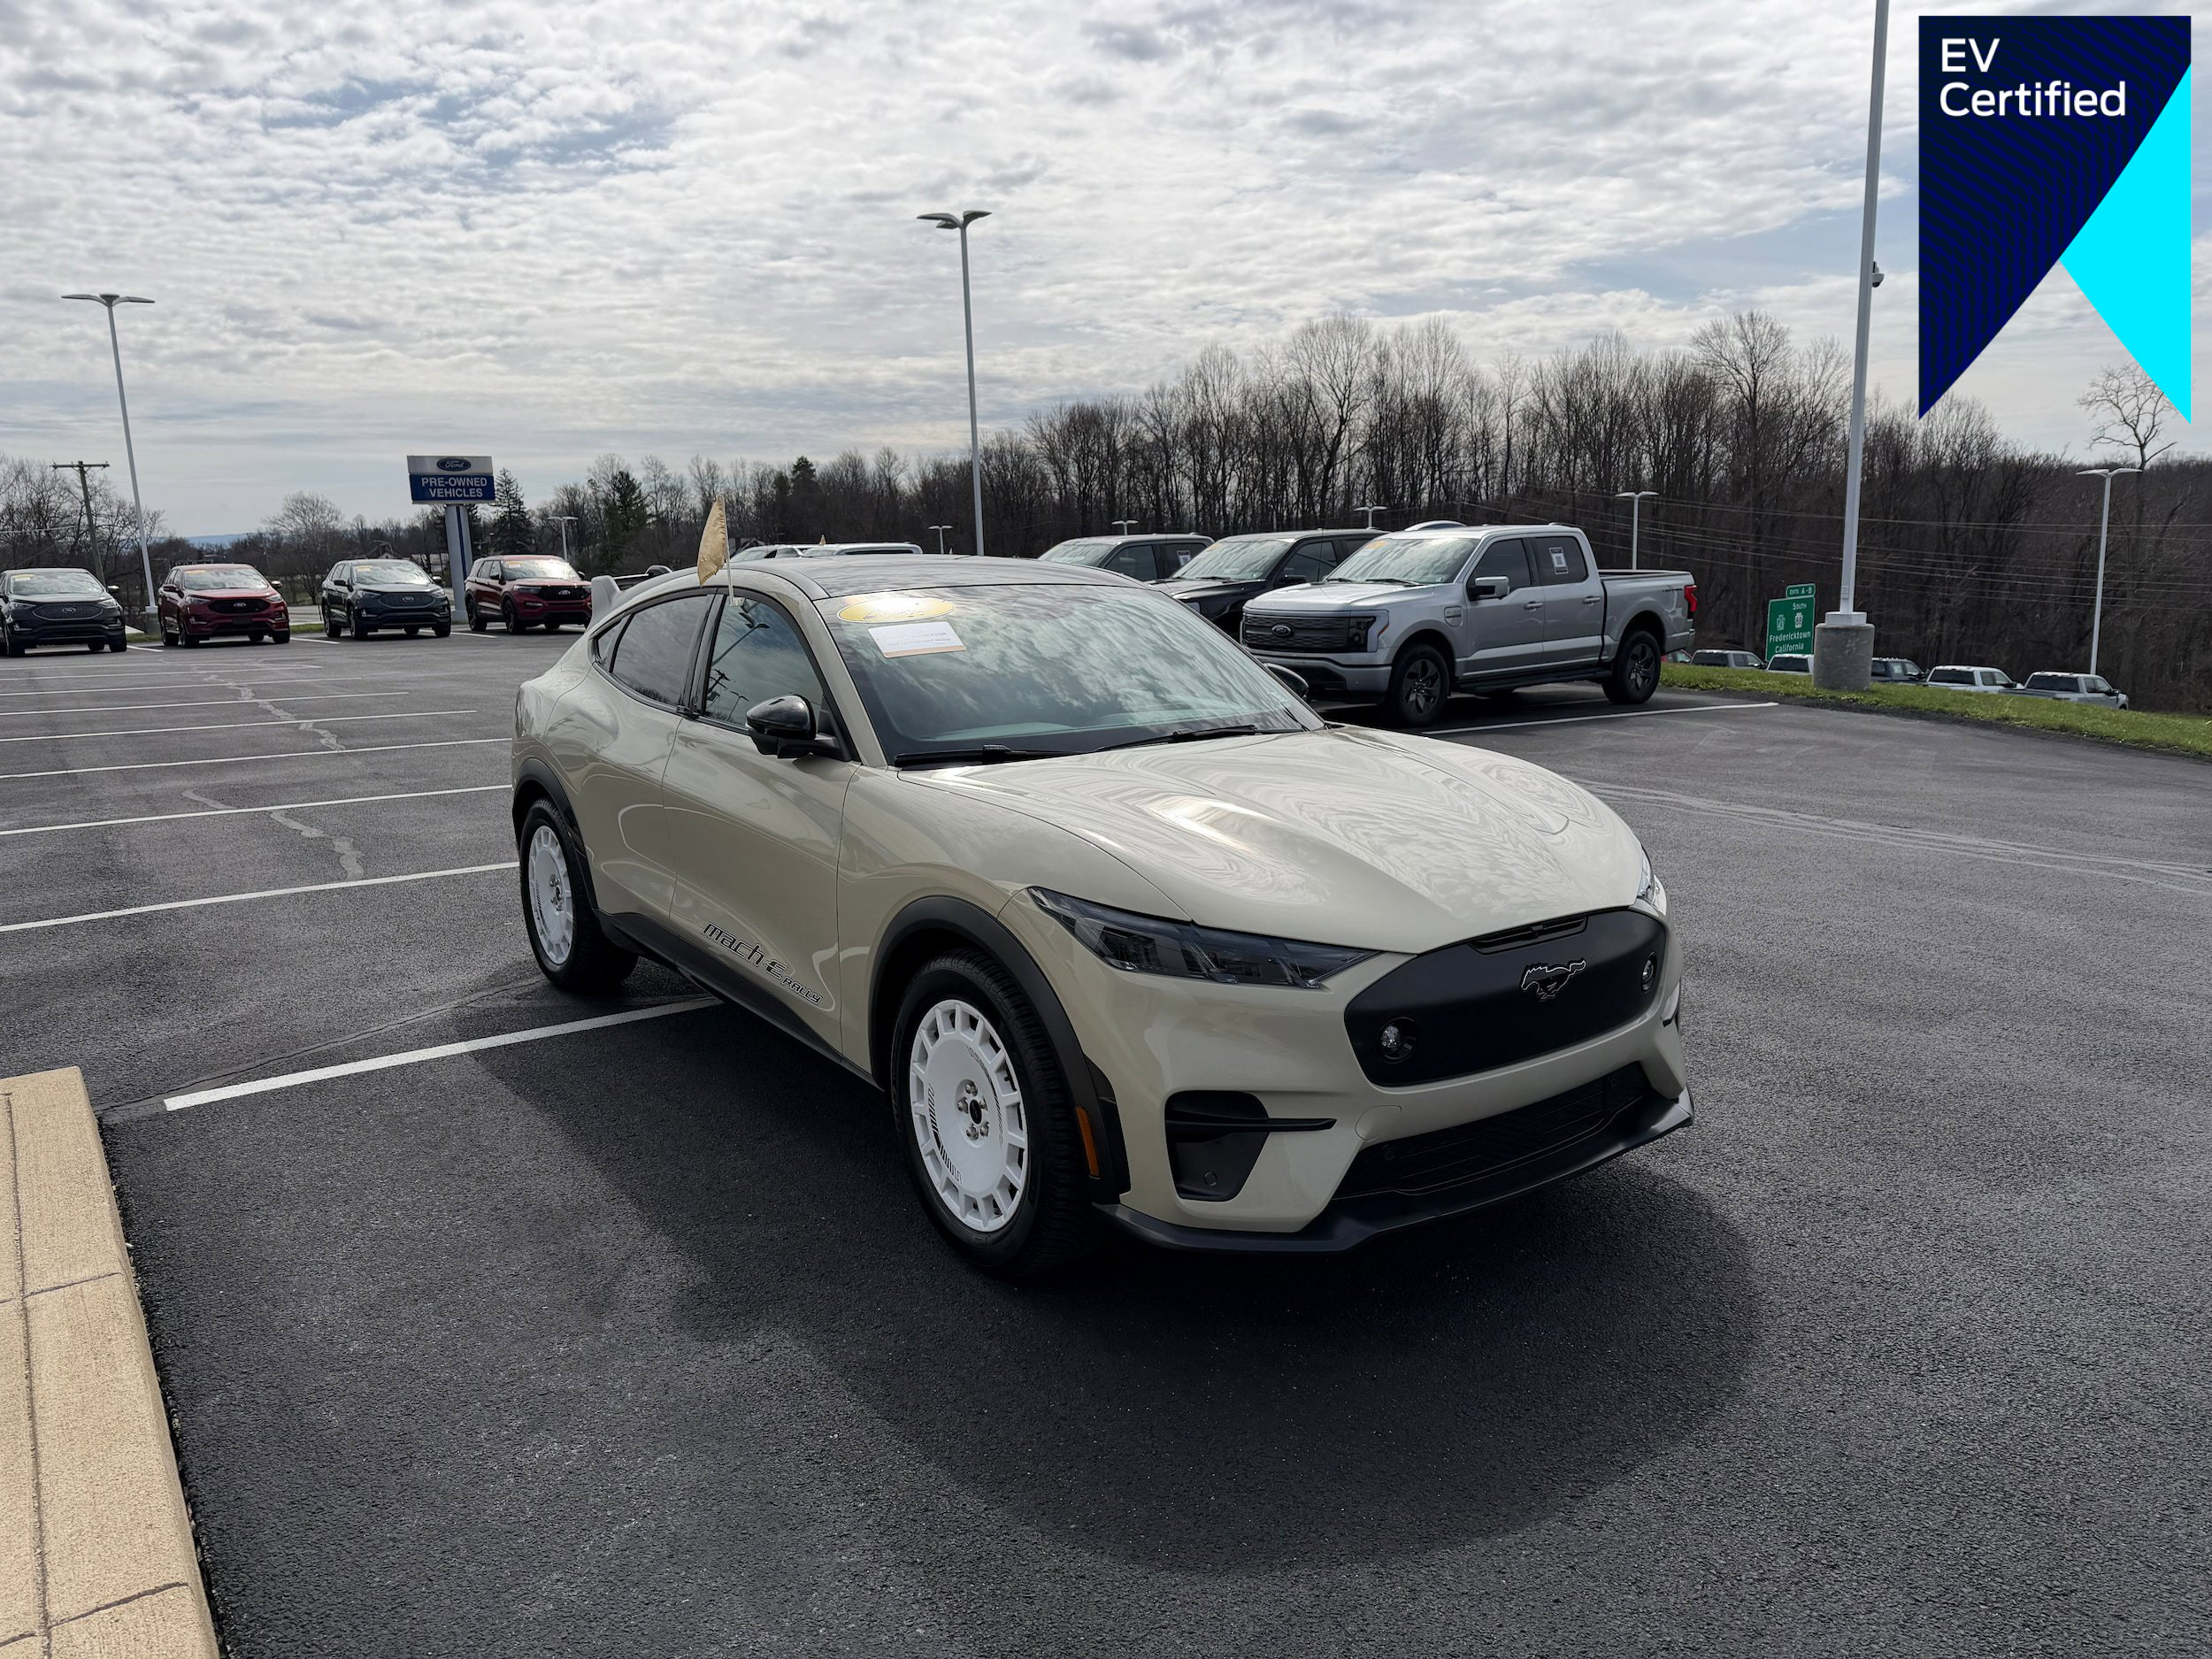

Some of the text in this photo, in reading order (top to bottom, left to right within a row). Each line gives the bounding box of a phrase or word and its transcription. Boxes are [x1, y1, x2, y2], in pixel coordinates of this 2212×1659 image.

[421, 477, 488, 487] PRE-OWNED
[429, 488, 483, 497] VEHICLES
[1770, 631, 1811, 642] Fredericktown
[1775, 642, 1804, 653] California
[780, 976, 823, 1005] RALLY
